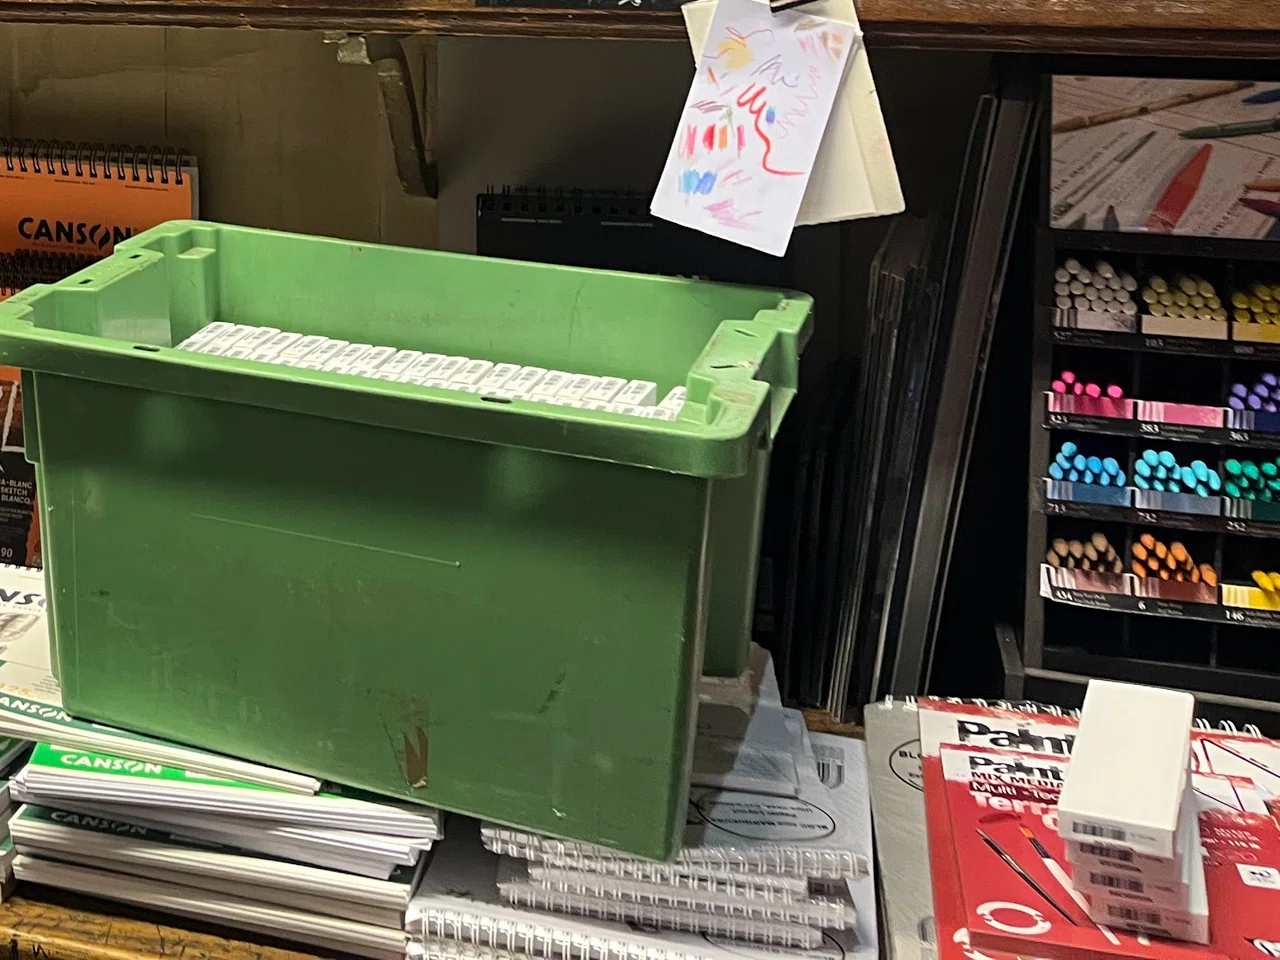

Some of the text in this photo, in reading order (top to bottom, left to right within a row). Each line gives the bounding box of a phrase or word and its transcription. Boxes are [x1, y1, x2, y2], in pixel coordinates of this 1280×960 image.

[18, 217, 132, 250] CANSON
[0, 486, 28, 496] SKETCH
[1, 494, 31, 504] BLANCO
[0, 547, 13, 558] 90
[1138, 601, 1147, 610] 6
[60, 754, 162, 774] CANSON
[971, 771, 1008, 783] MIX
[972, 781, 1017, 796] Multi
[50, 811, 148, 836] CANSON
